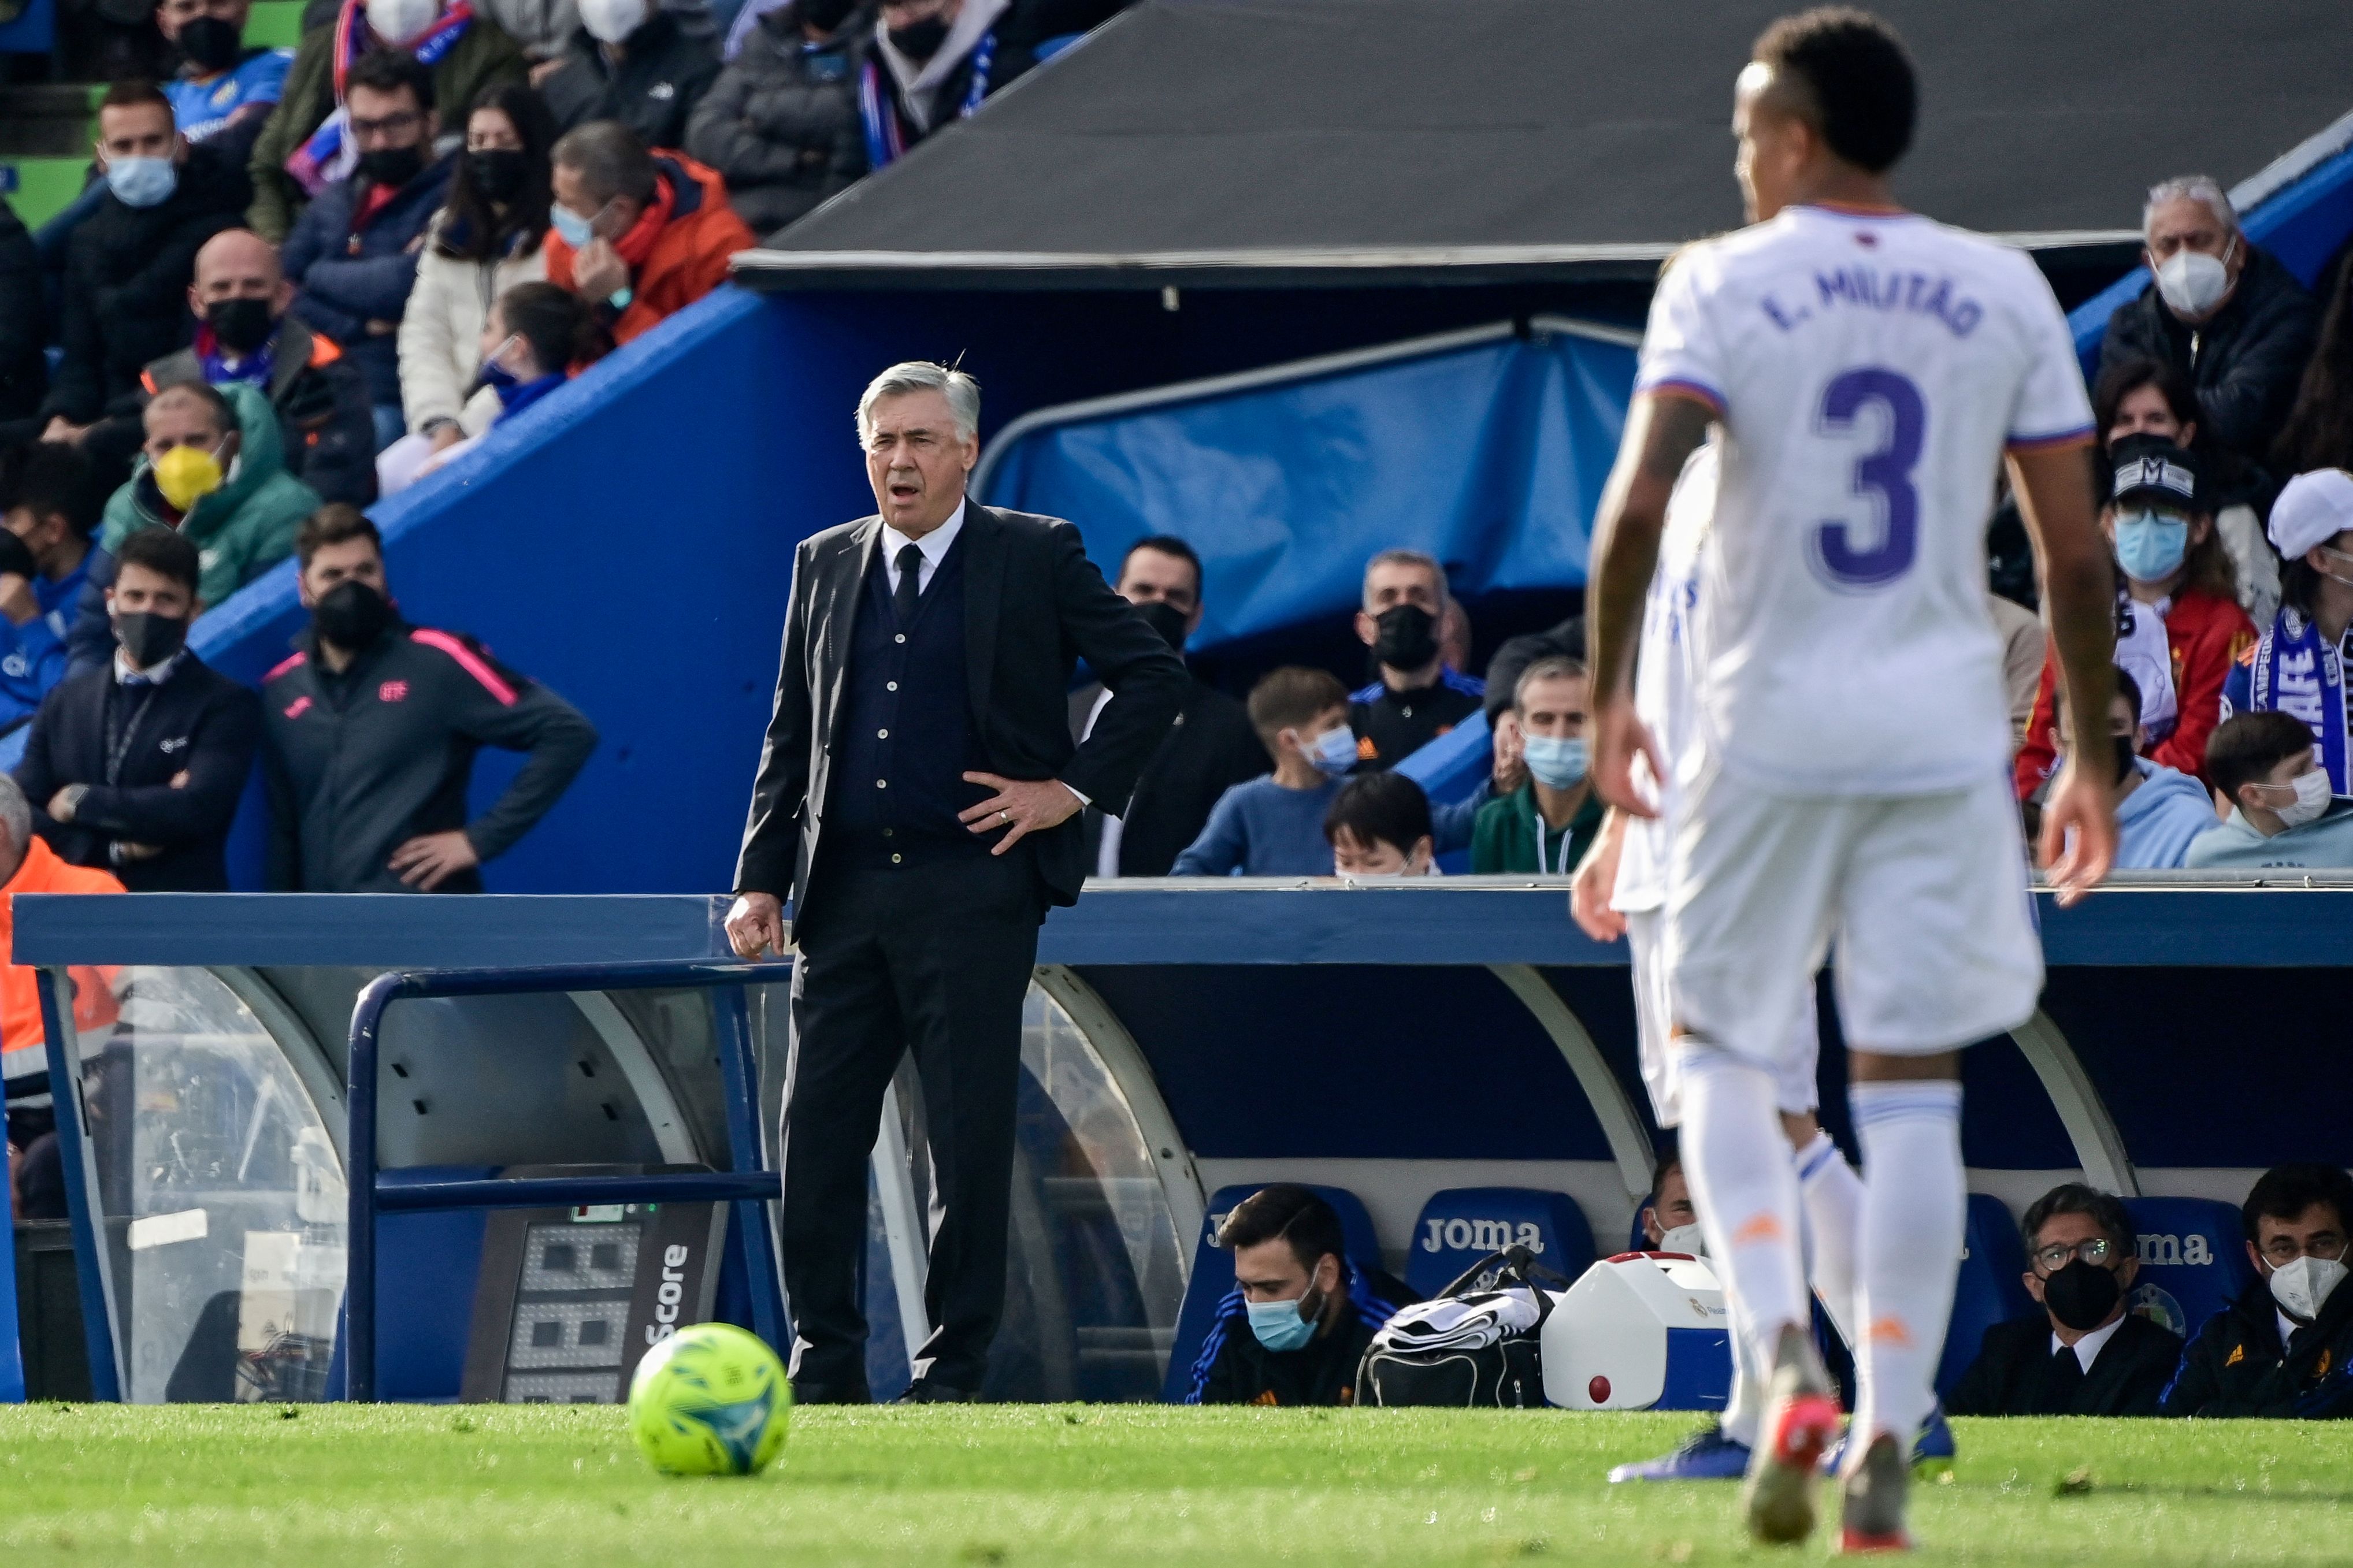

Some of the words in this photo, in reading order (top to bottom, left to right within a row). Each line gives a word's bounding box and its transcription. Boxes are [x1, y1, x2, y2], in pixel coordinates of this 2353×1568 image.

[1818, 366, 1927, 589] 3
[2139, 456, 2168, 484] M
[2136, 1233, 2214, 1266] ma
[644, 1244, 688, 1346] Score
